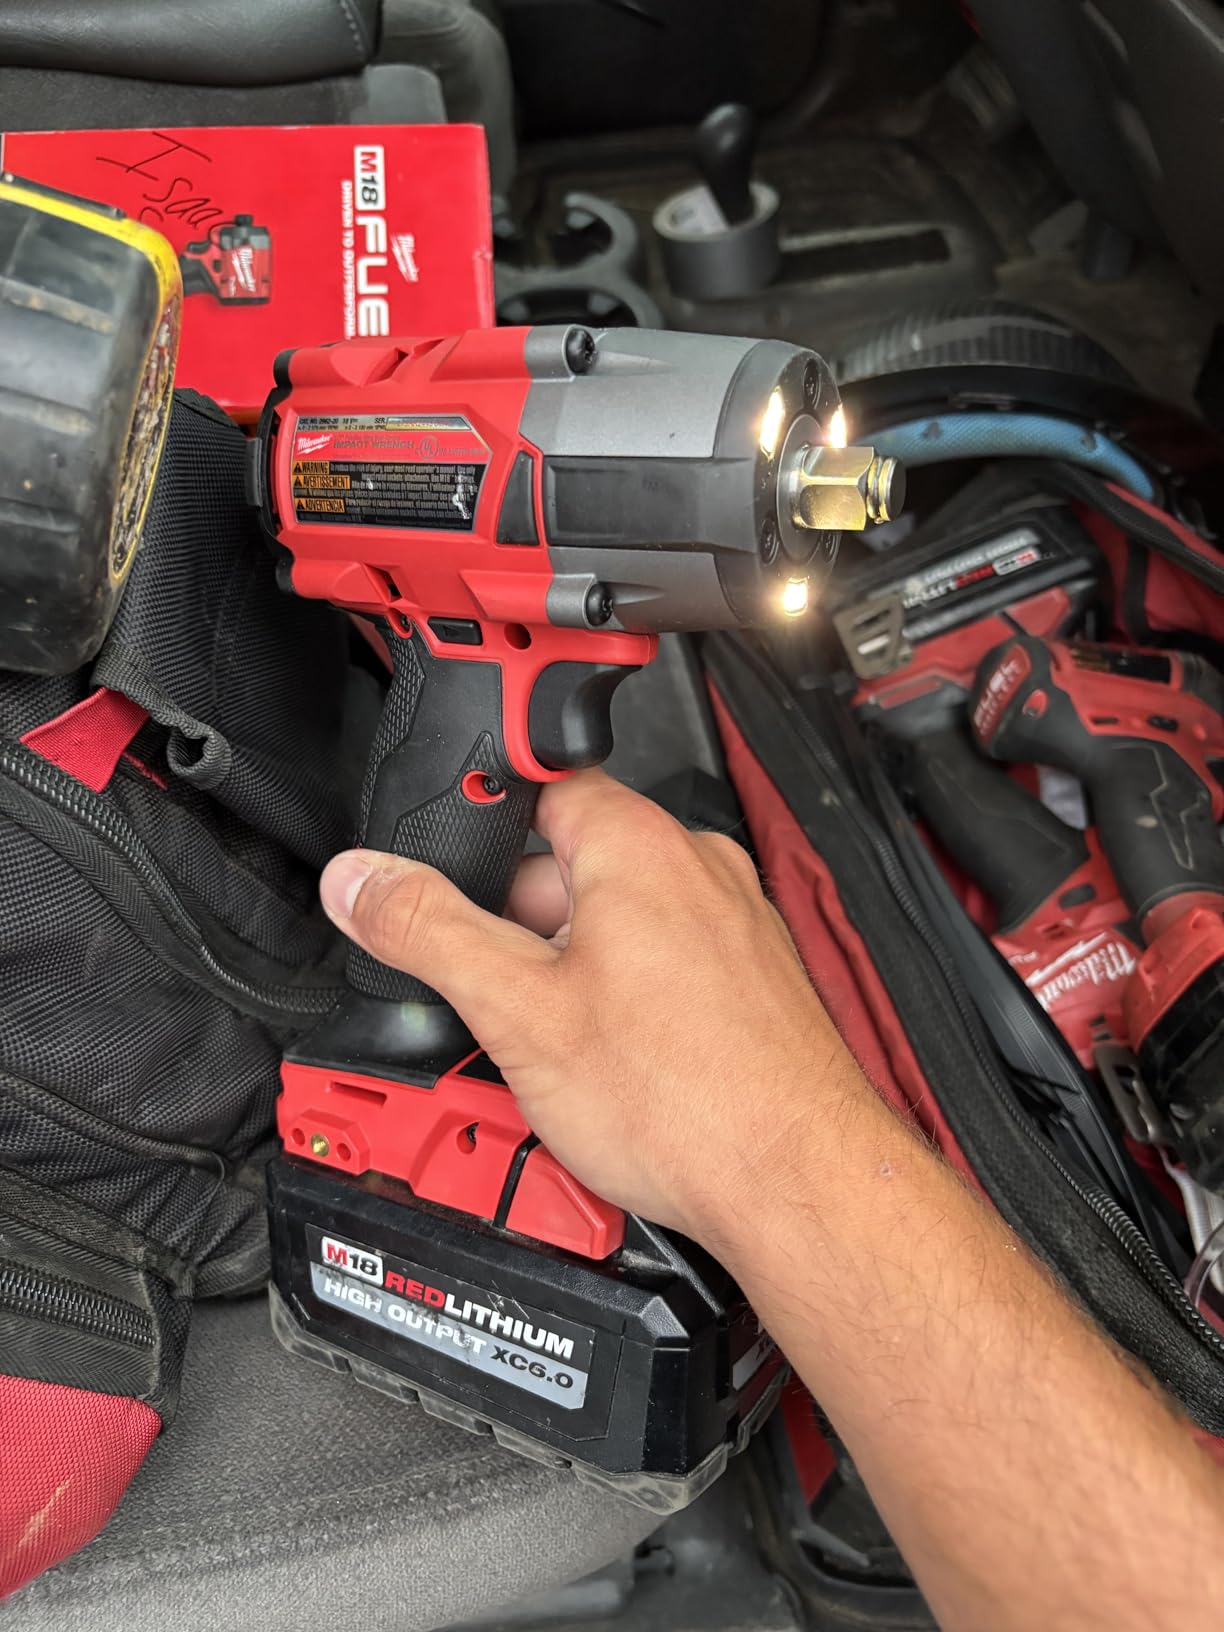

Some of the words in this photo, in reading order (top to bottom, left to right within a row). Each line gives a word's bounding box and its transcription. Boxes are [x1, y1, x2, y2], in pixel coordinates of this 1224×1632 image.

[359, 149, 381, 207] M18
[340, 180, 354, 228] DRIVEN
[341, 229, 355, 248] TO
[297, 434, 333, 450] Milwaukee
[301, 462, 329, 474] WARNING
[303, 475, 349, 489] AVERTISSEMENT
[305, 499, 344, 513] ADVERTENCIA
[325, 1242, 378, 1277] M18
[384, 1270, 576, 1361] REDLITHIUM
[323, 1278, 382, 1313] HIGH
[387, 1303, 487, 1355] OUTPUT
[490, 1344, 574, 1390] XC6.0
